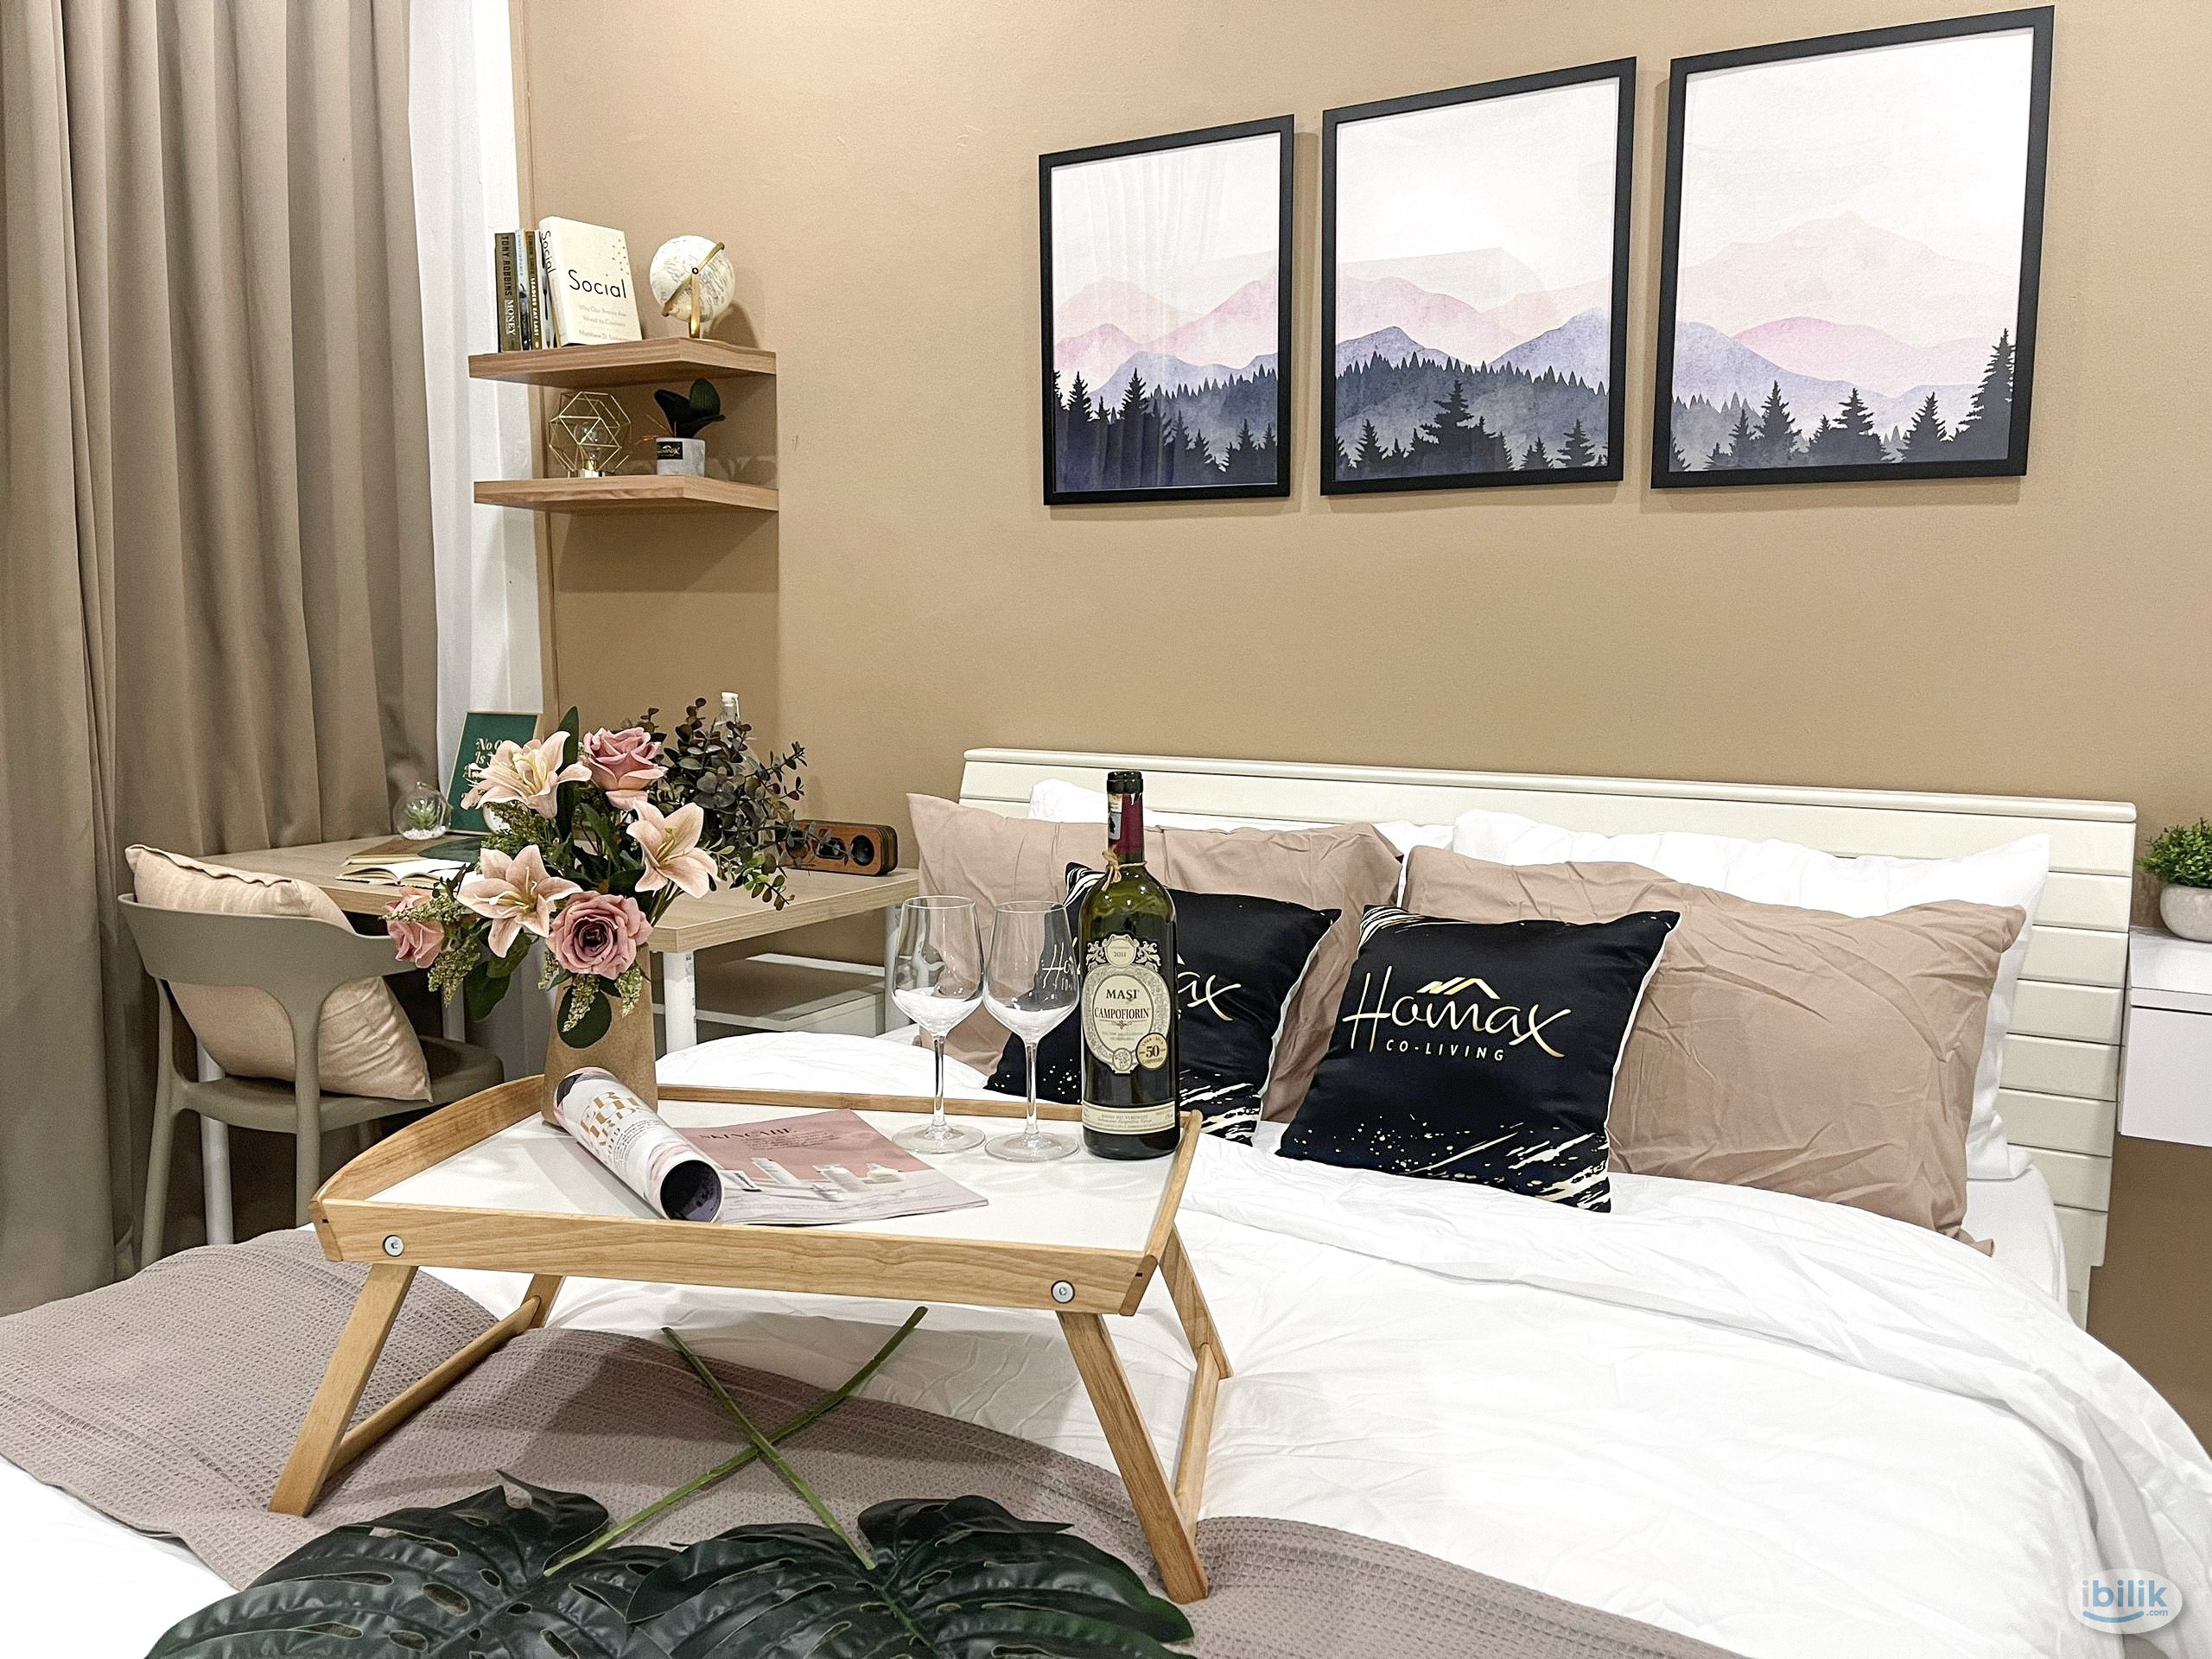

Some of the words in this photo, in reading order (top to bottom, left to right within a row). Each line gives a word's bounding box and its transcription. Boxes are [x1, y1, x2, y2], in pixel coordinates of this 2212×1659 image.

[542, 230, 556, 274] Social
[568, 269, 626, 299] Social
[506, 299, 516, 335] MONEY
[475, 738, 493, 751] No
[475, 751, 486, 765] Is
[1106, 988, 1138, 1001] MASI
[1094, 1007, 1149, 1020] CAMPOFIORIN
[1342, 965, 1572, 1058] Homax
[1146, 1045, 1160, 1058] 50
[1386, 1039, 1504, 1061] CO-LIVING
